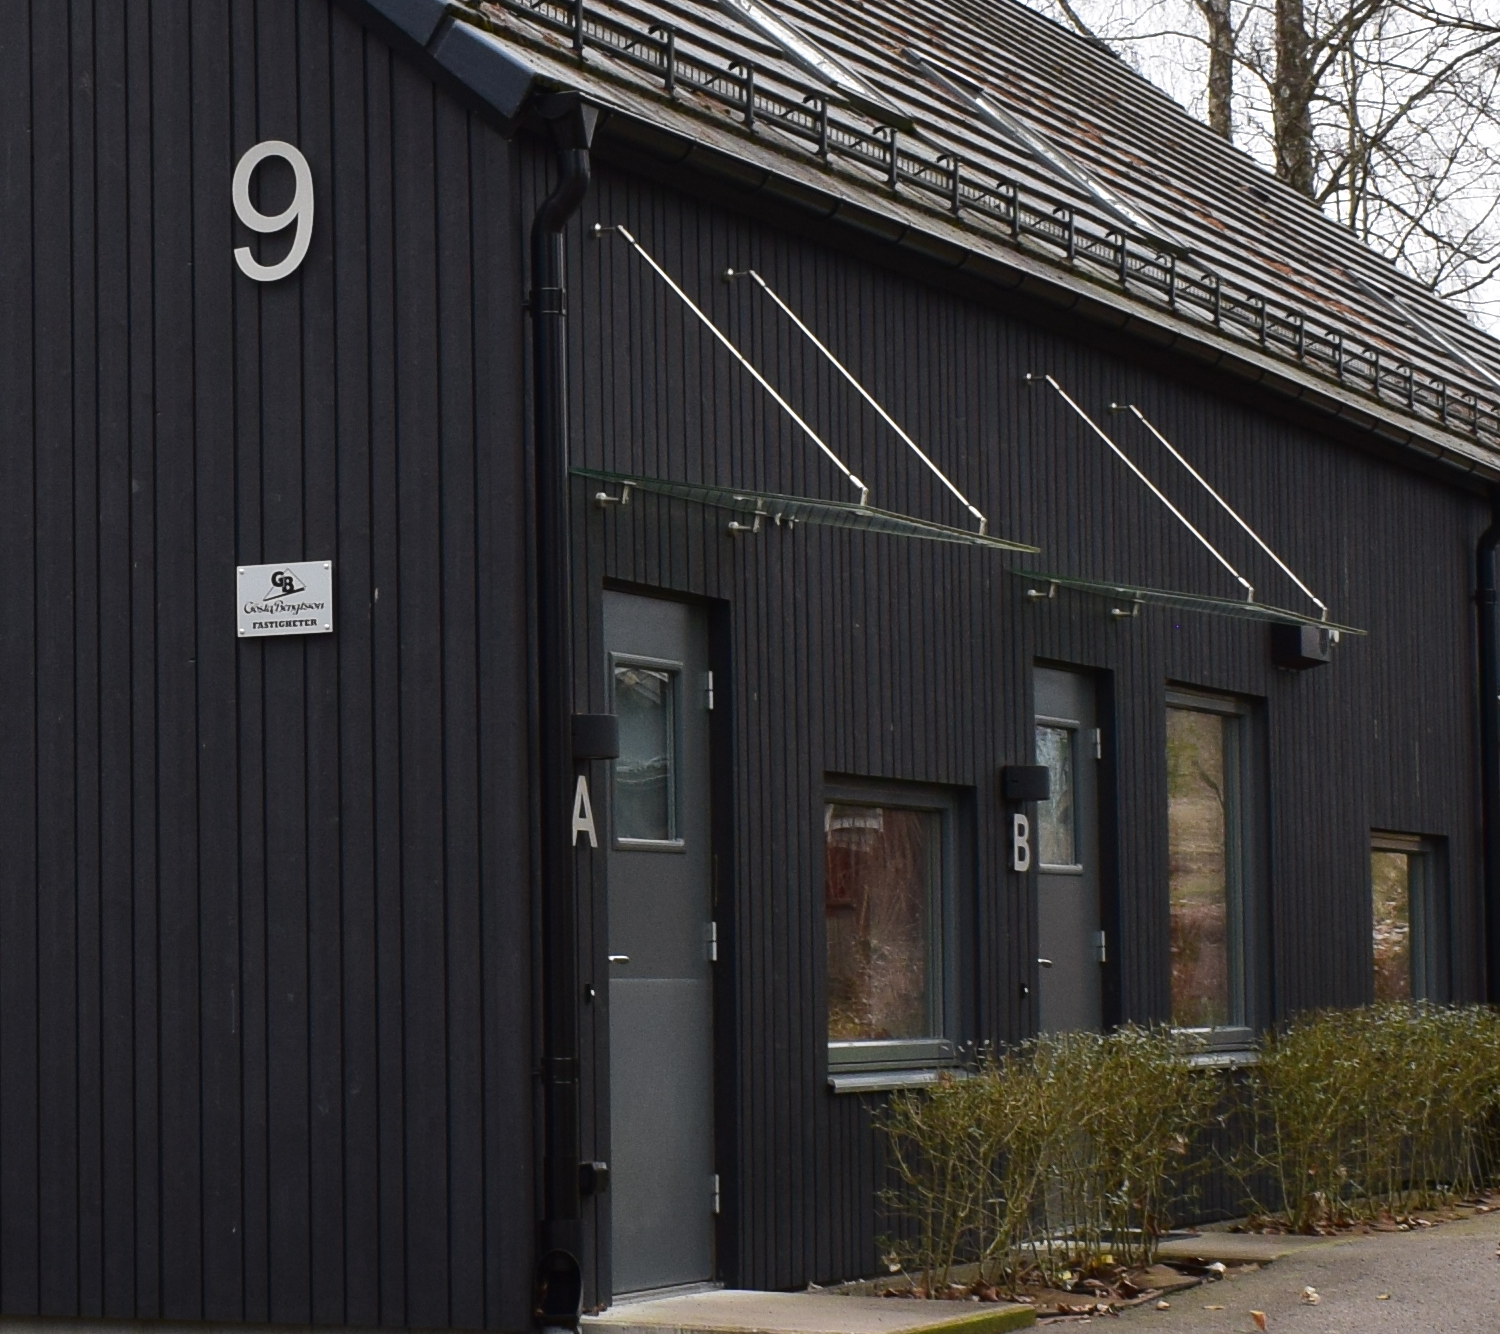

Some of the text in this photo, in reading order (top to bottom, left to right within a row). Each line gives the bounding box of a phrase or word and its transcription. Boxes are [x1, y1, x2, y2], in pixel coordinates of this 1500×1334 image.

[232, 140, 315, 282] 9
[271, 570, 295, 593] GB
[252, 618, 318, 630] FASTIGHETER
[572, 775, 598, 848] A
[1014, 813, 1031, 872] B
